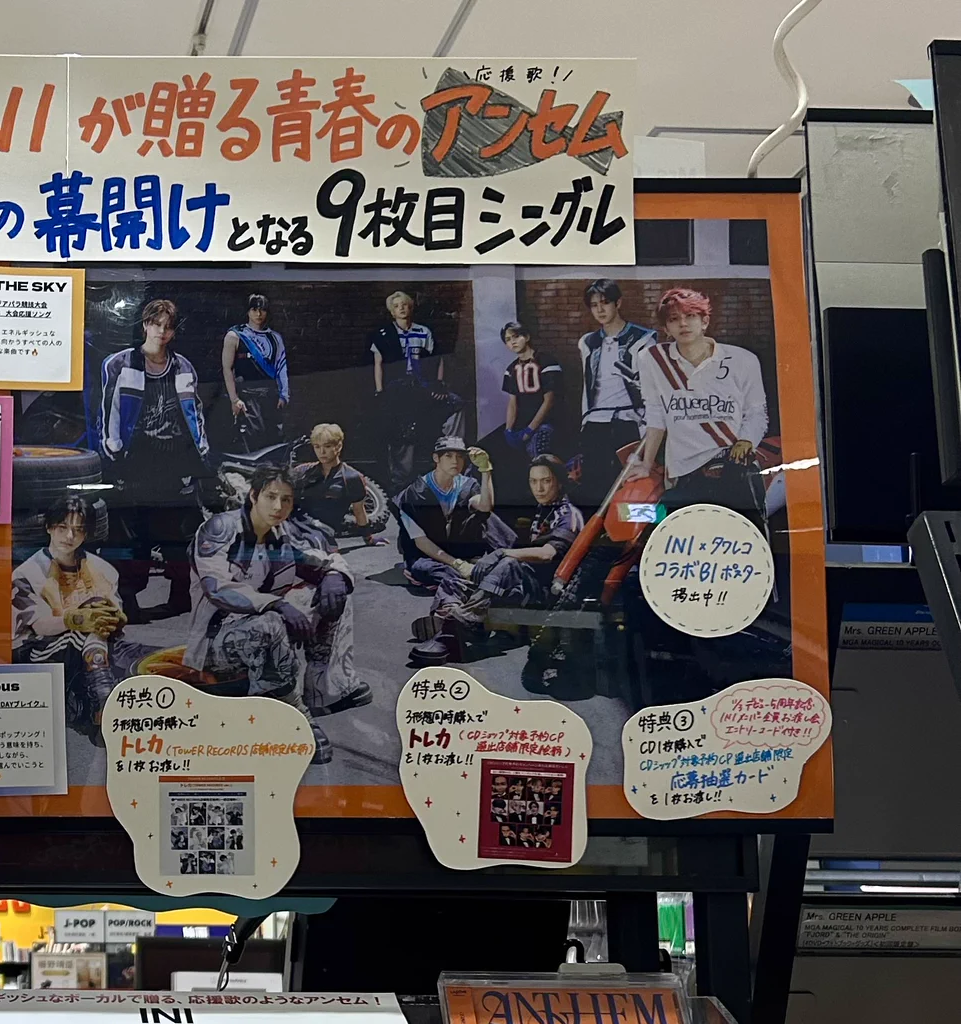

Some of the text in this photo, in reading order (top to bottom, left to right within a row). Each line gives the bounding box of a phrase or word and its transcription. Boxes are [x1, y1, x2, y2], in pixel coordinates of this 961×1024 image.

[31, 281, 68, 293] SKY
[716, 357, 732, 380] 5
[514, 363, 541, 393] 10
[867, 627, 902, 635] GREEN
[904, 627, 938, 636] APPLE
[409, 728, 451, 748] トレカ
[121, 734, 164, 757] トレカ
[64, 918, 96, 928] J-POP
[107, 918, 152, 928] POP/ROCK
[828, 912, 897, 922] GREEN APPLE
[139, 1007, 194, 1024] INI
